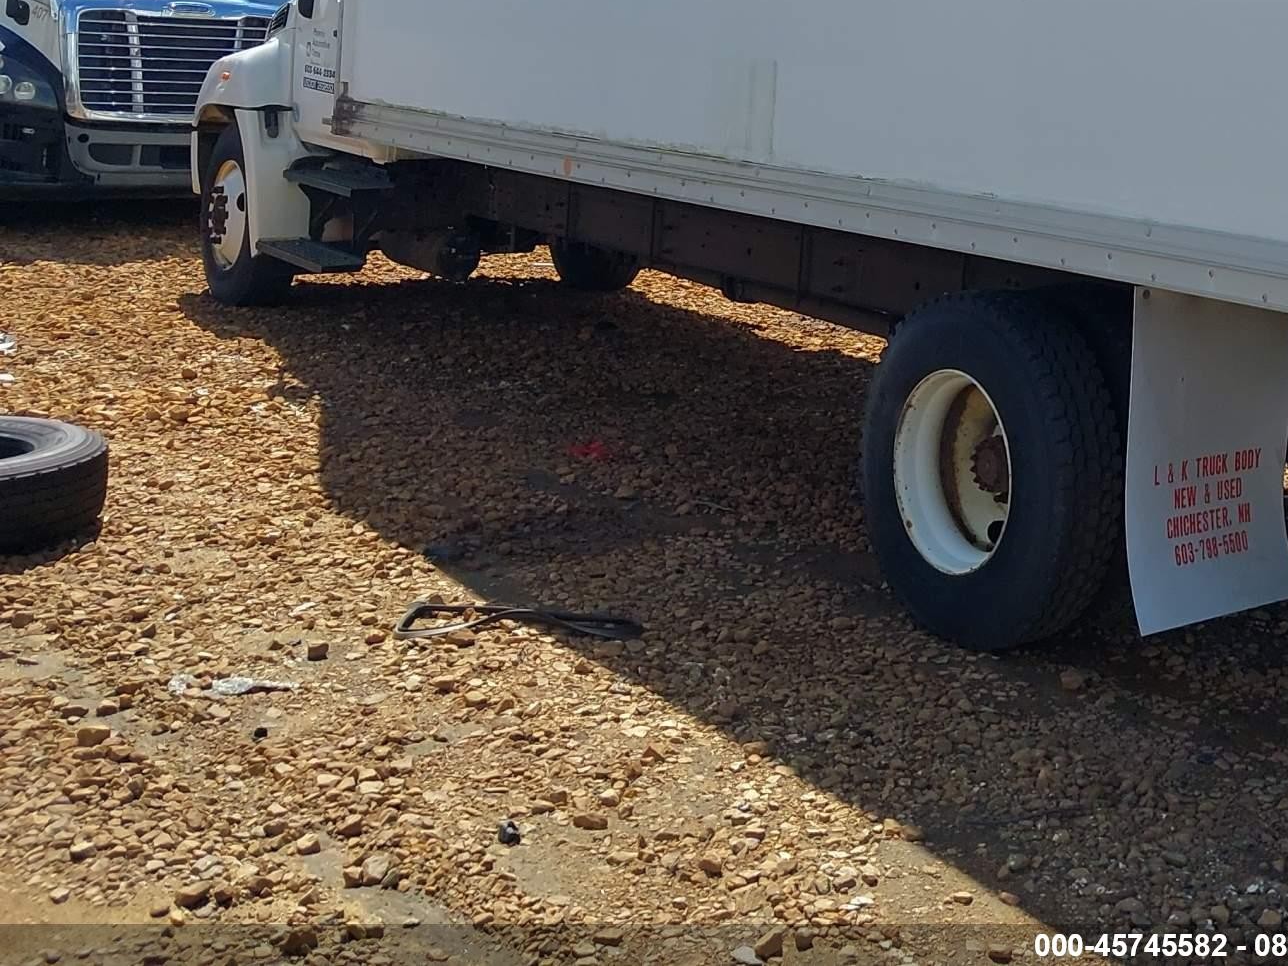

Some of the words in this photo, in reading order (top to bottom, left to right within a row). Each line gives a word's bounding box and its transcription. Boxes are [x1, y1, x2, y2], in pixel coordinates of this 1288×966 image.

[1154, 465, 1160, 486] L
[1167, 463, 1174, 483] &
[1181, 461, 1188, 481] K
[1196, 454, 1228, 478] TRUCK
[1235, 448, 1262, 471] BODY
[1174, 486, 1197, 509] NEW
[1204, 484, 1210, 504] &
[1217, 477, 1242, 500] USED
[1167, 507, 1233, 539] CHICHESTER,
[1238, 503, 1251, 523] NH
[1174, 530, 1249, 566] 603-798-5500
